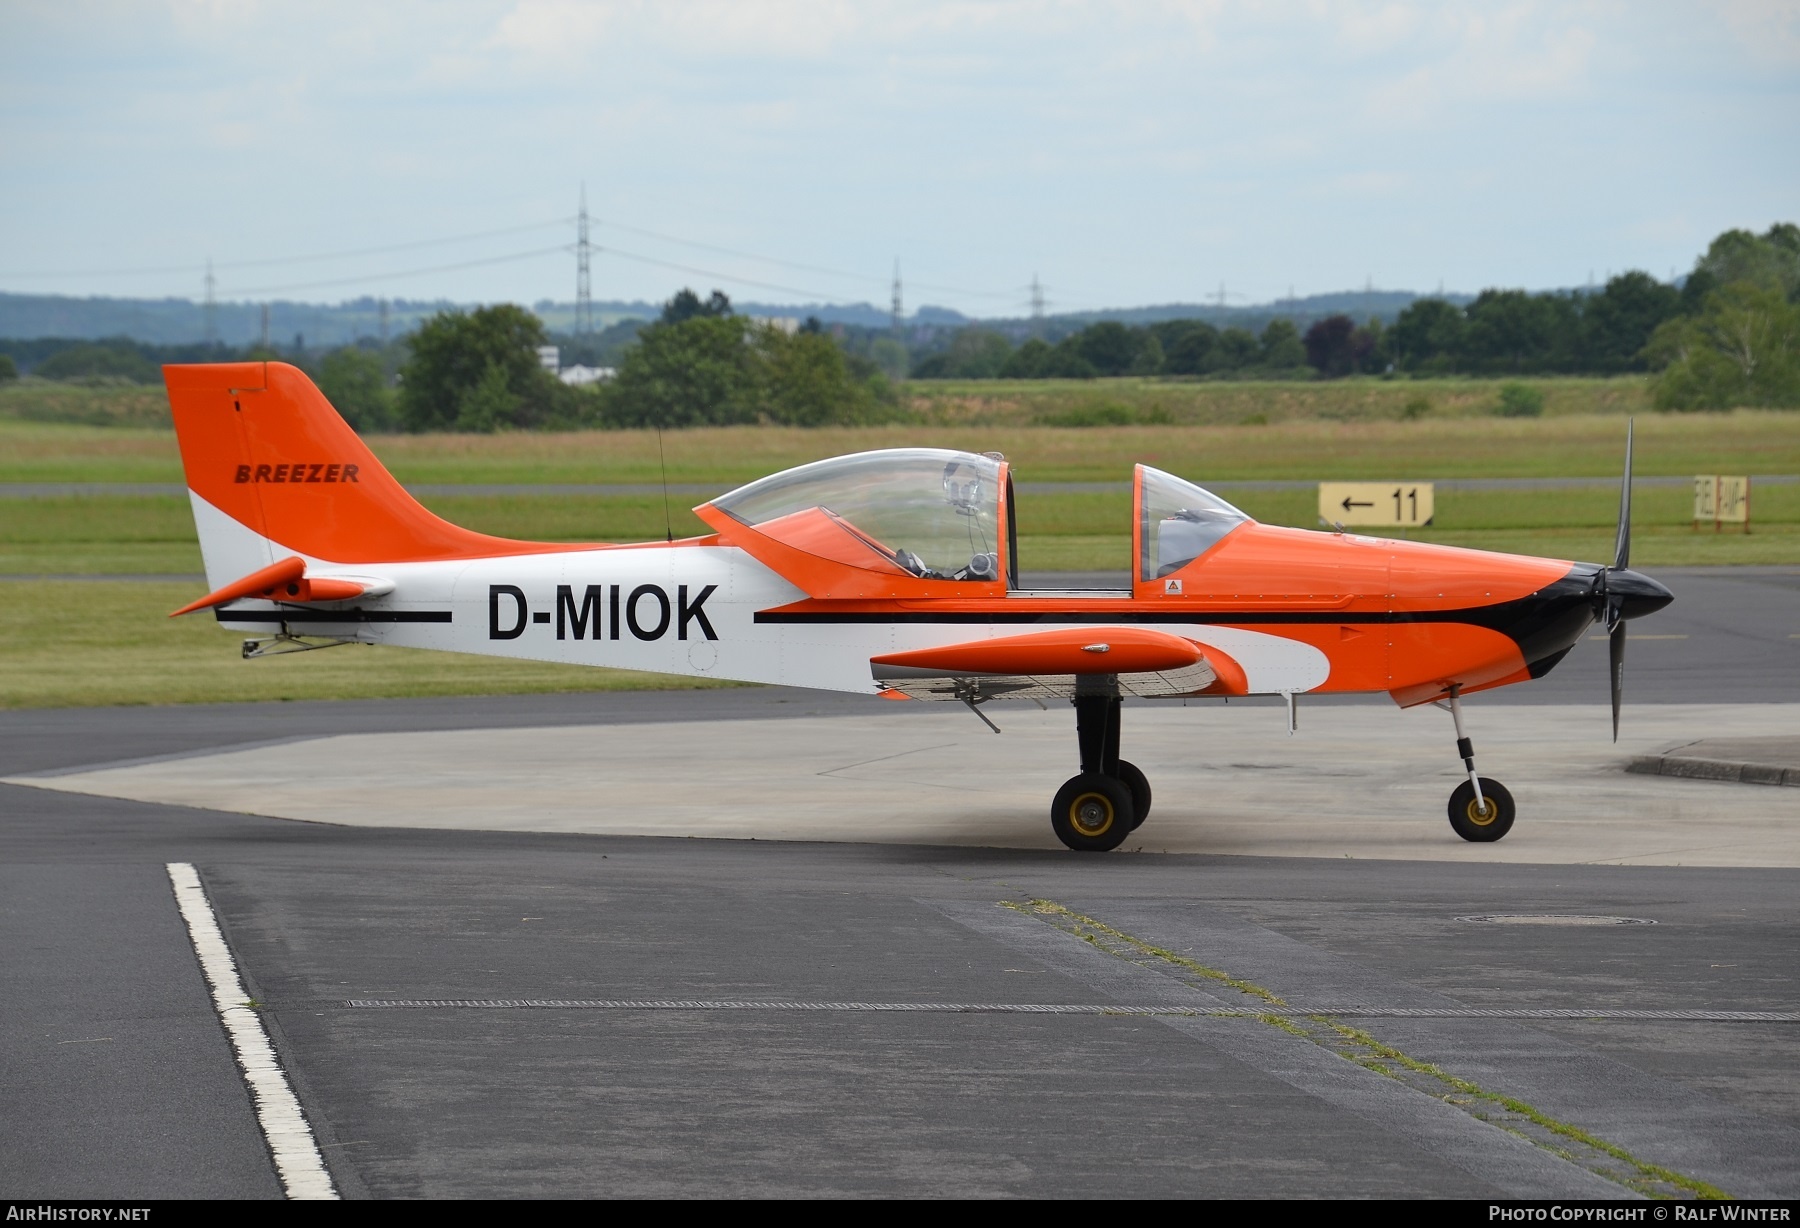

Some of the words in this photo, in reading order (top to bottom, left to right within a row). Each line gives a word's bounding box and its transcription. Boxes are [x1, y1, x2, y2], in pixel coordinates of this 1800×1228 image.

[234, 464, 359, 483] BREEZER
[1392, 488, 1417, 521] 11
[489, 583, 719, 642] D-MIOK
